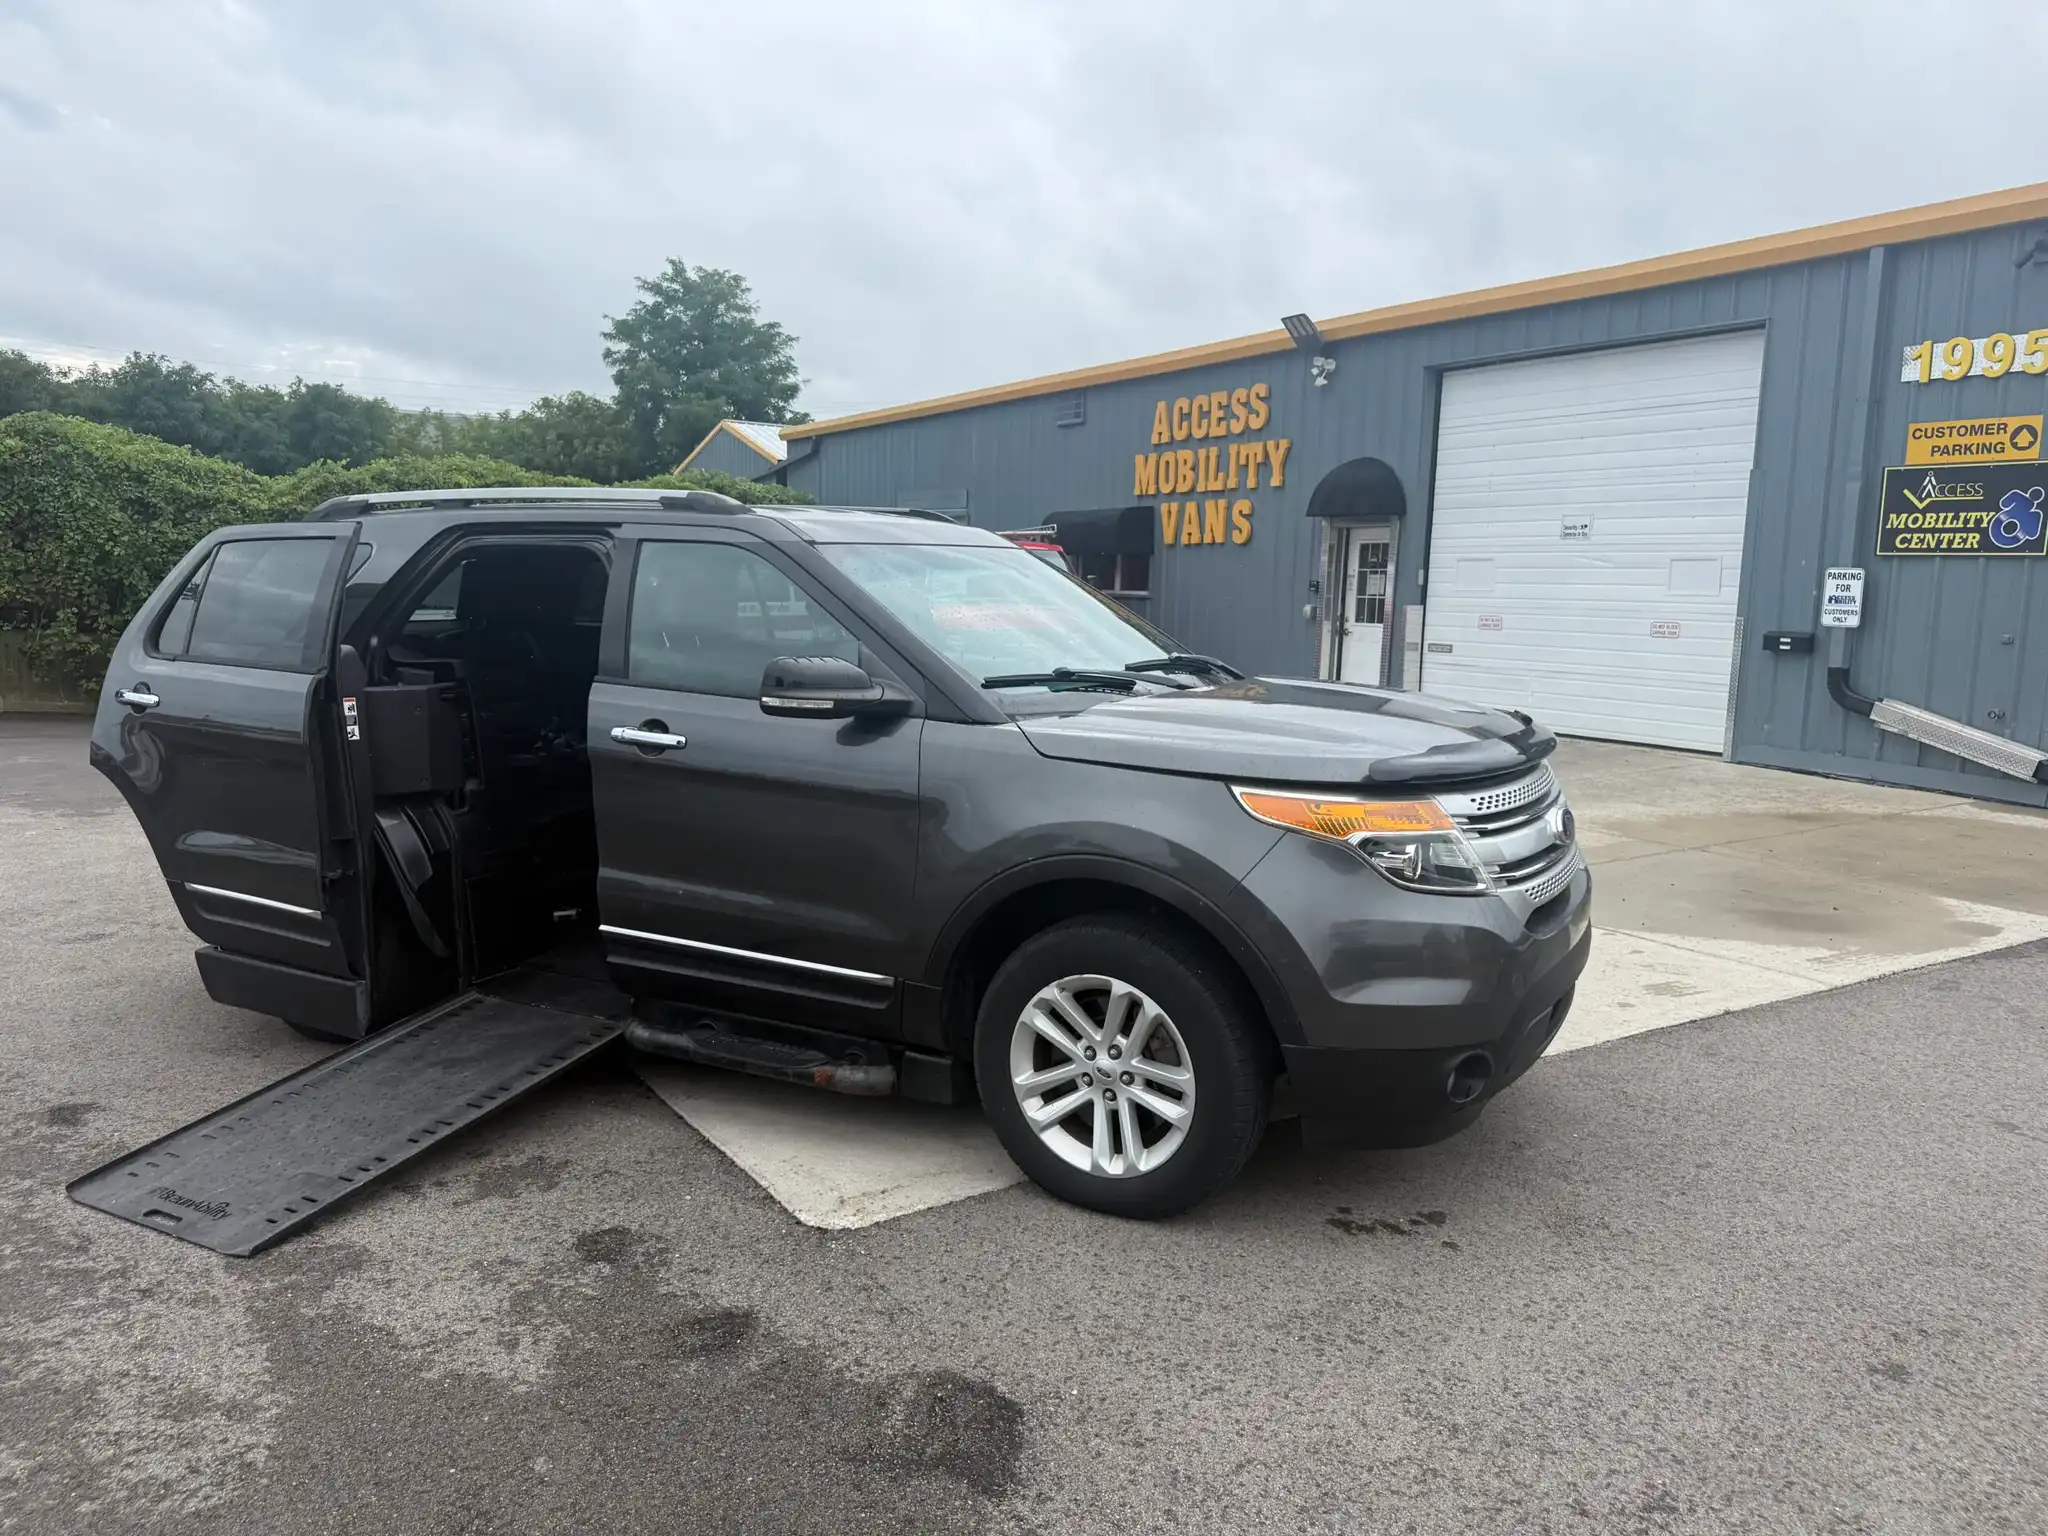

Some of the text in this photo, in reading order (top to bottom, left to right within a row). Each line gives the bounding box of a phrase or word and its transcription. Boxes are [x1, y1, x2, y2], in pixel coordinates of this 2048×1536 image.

[1911, 328, 2048, 383] 1995
[1151, 383, 1270, 445] ACCESS
[1912, 423, 2009, 440] CUSTOMER
[1931, 441, 2006, 457] PARKING
[1134, 438, 1291, 496] MOBILITY
[1917, 472, 1984, 498] ACCESS
[1160, 499, 1253, 545] VANS
[1886, 512, 1996, 529] MOBILITY
[1895, 533, 1981, 549] CENTER
[1828, 572, 1861, 580] PARKING
[1836, 584, 1851, 592] FOR
[1824, 608, 1858, 616] CUSTOMERS
